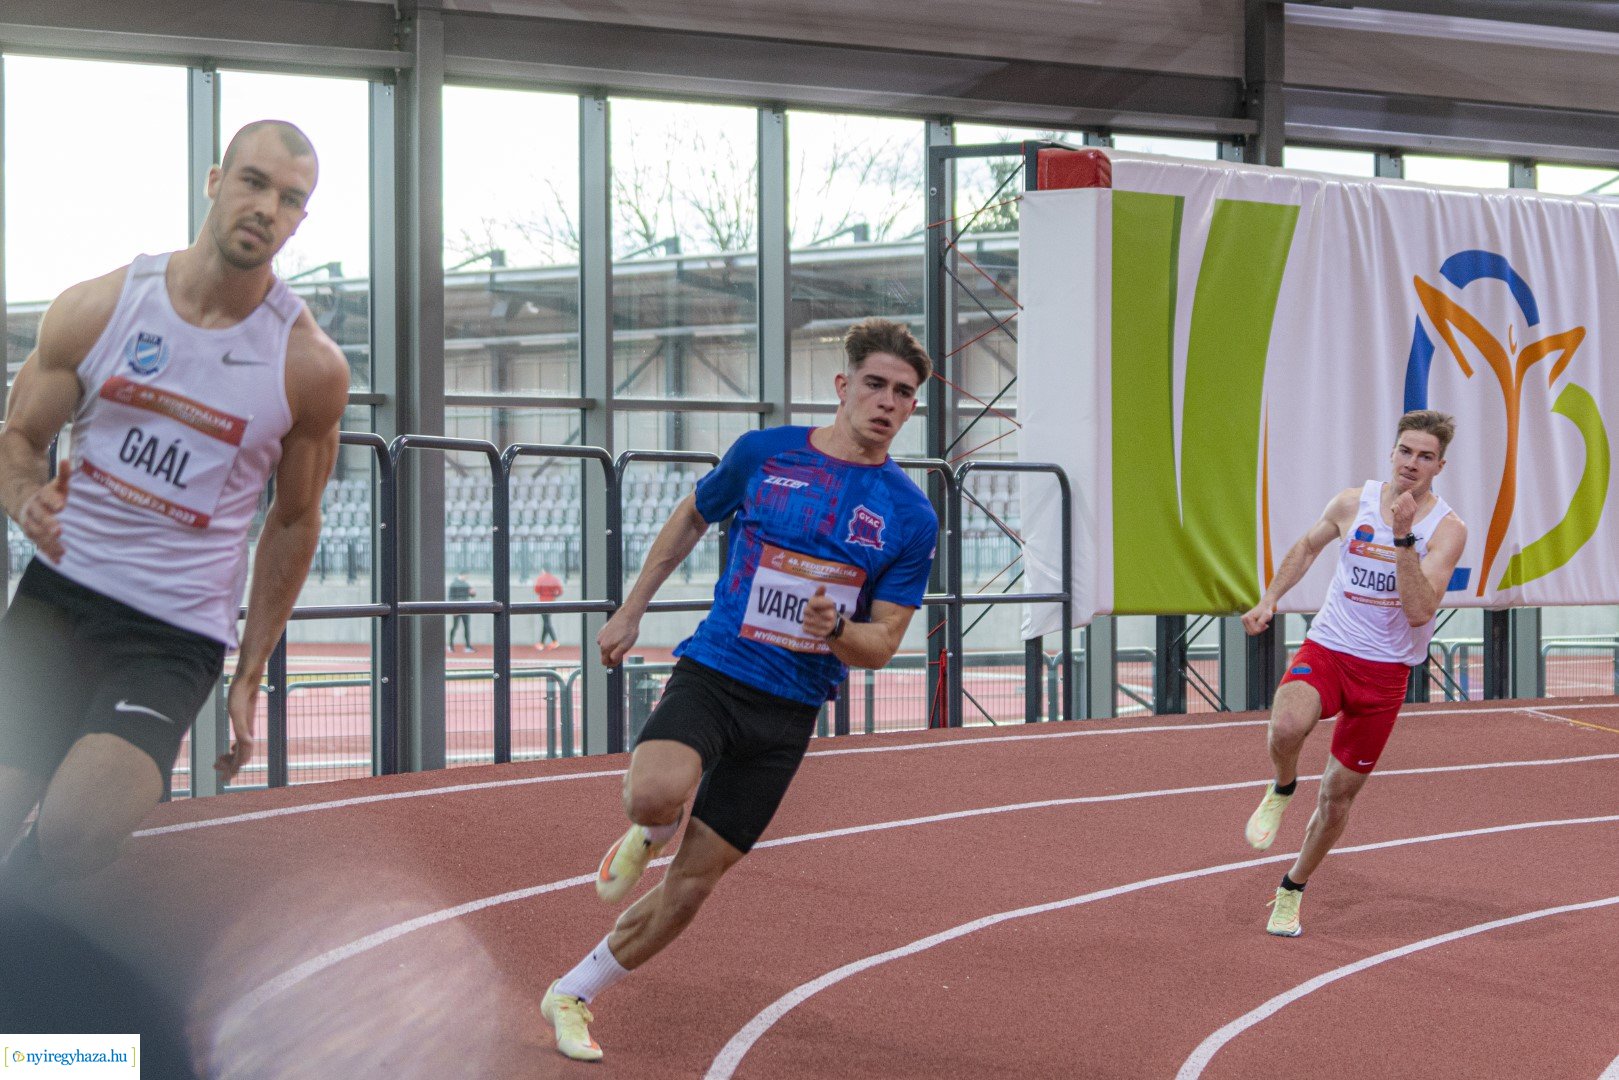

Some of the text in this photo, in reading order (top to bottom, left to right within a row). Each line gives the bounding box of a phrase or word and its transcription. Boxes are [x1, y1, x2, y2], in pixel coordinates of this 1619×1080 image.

[119, 427, 189, 490] GAÁL
[859, 512, 880, 528] GYAC
[1351, 566, 1396, 592] SZABÓ
